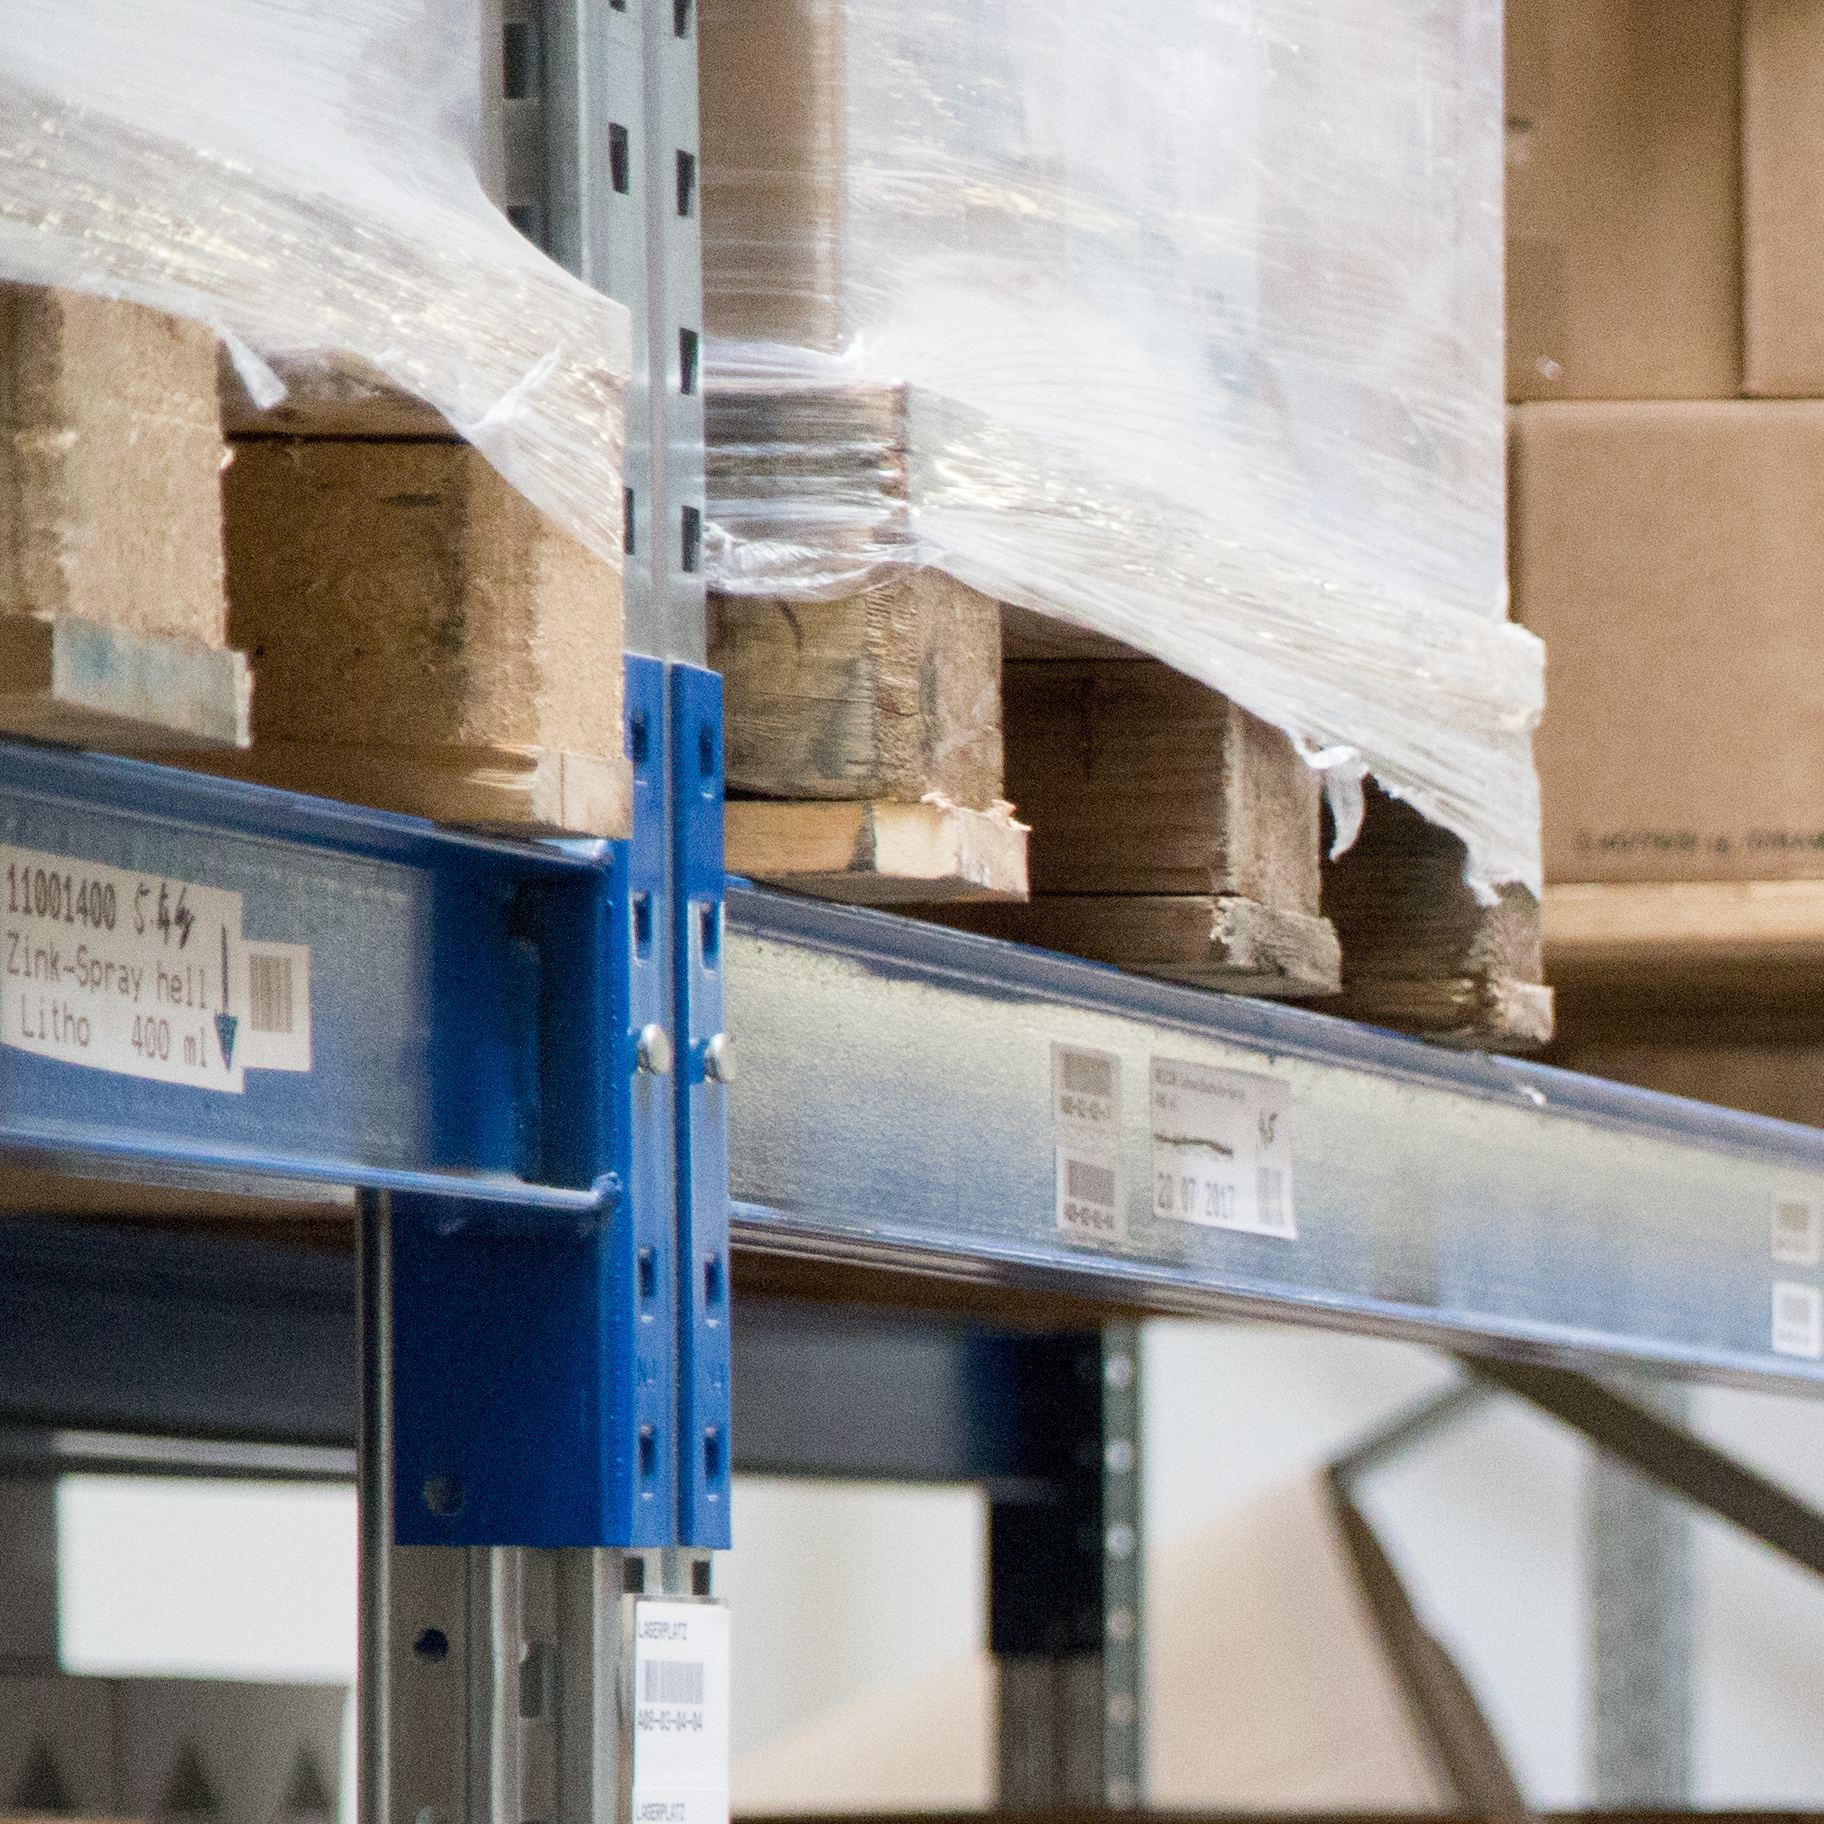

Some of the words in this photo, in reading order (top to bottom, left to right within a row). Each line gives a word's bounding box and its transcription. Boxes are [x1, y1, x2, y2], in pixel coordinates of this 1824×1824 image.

[6, 862, 117, 931] 11001400
[6, 929, 143, 1002] Zink-Spray
[156, 960, 207, 1010] hell
[21, 995, 90, 1047] Litho
[132, 1013, 170, 1061] 400
[183, 1026, 207, 1068] ml
